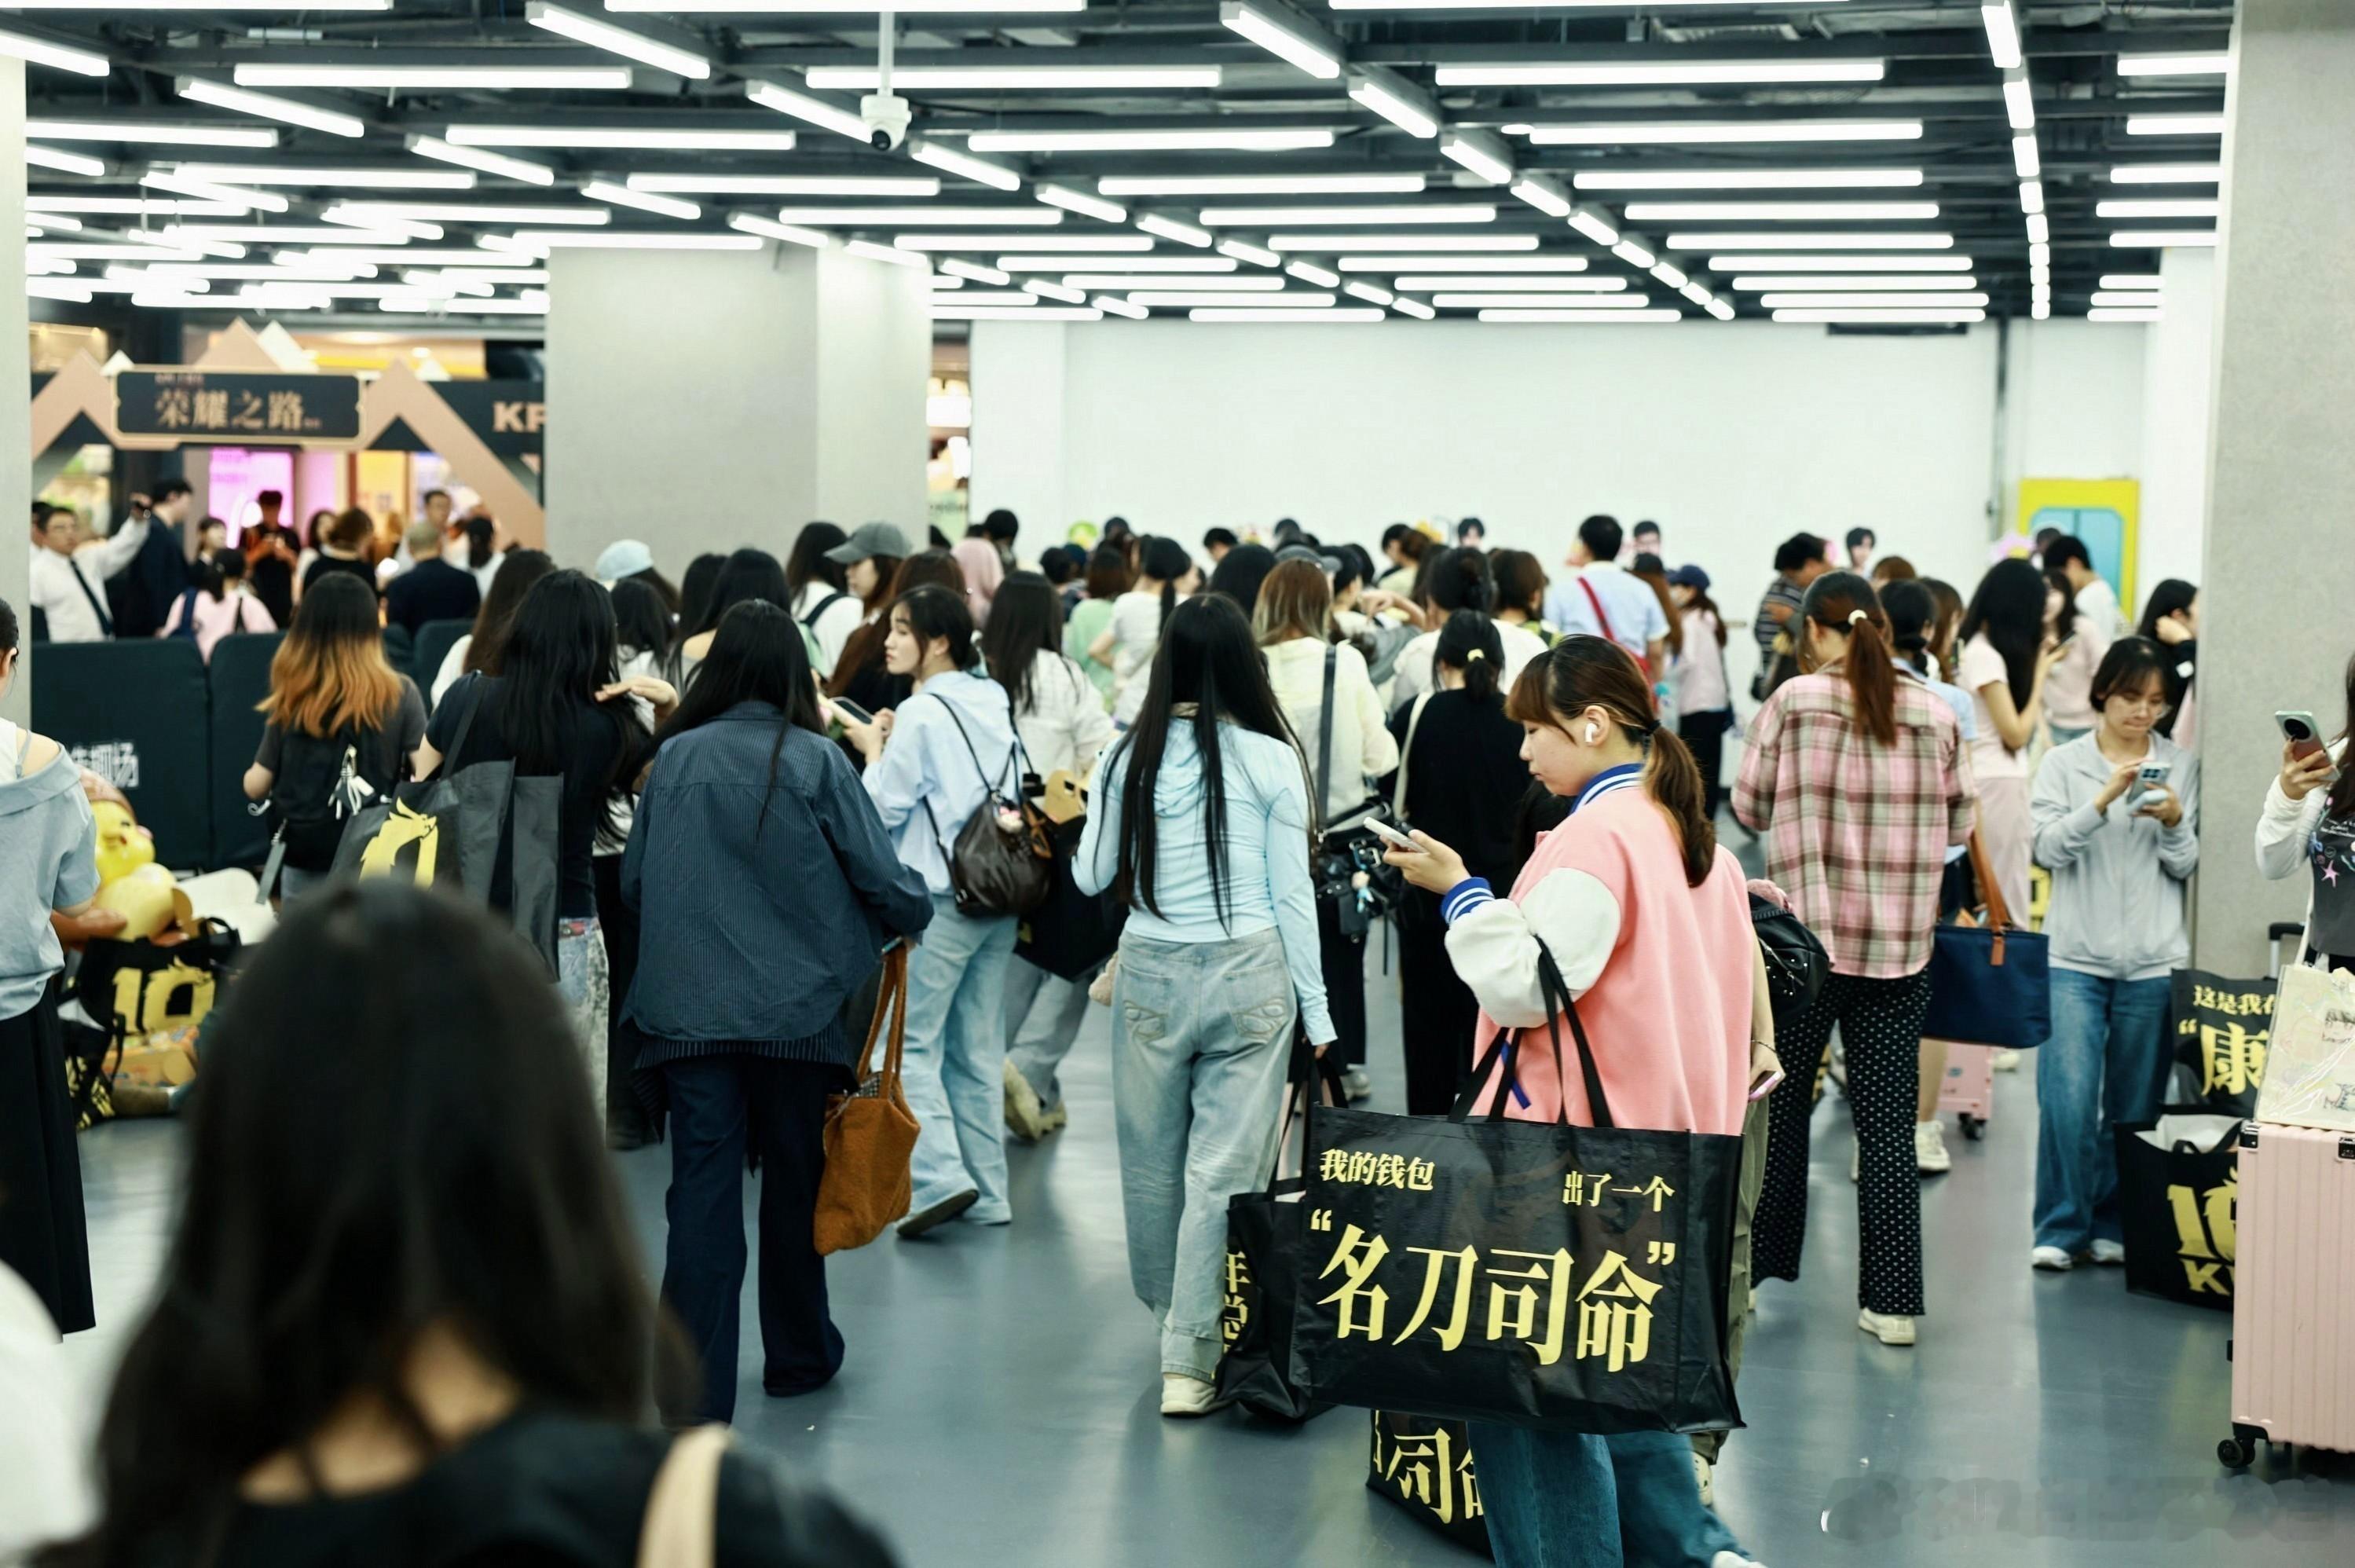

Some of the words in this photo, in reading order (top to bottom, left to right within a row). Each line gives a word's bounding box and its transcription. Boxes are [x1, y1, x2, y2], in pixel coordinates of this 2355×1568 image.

[155, 387, 302, 430] 荣耀之路
[1319, 1149, 1435, 1191] 我的钱包
[1562, 1171, 1676, 1212] 出了一个
[1310, 1208, 1676, 1372] “名刀司命”
[2181, 1258, 2235, 1296] K
